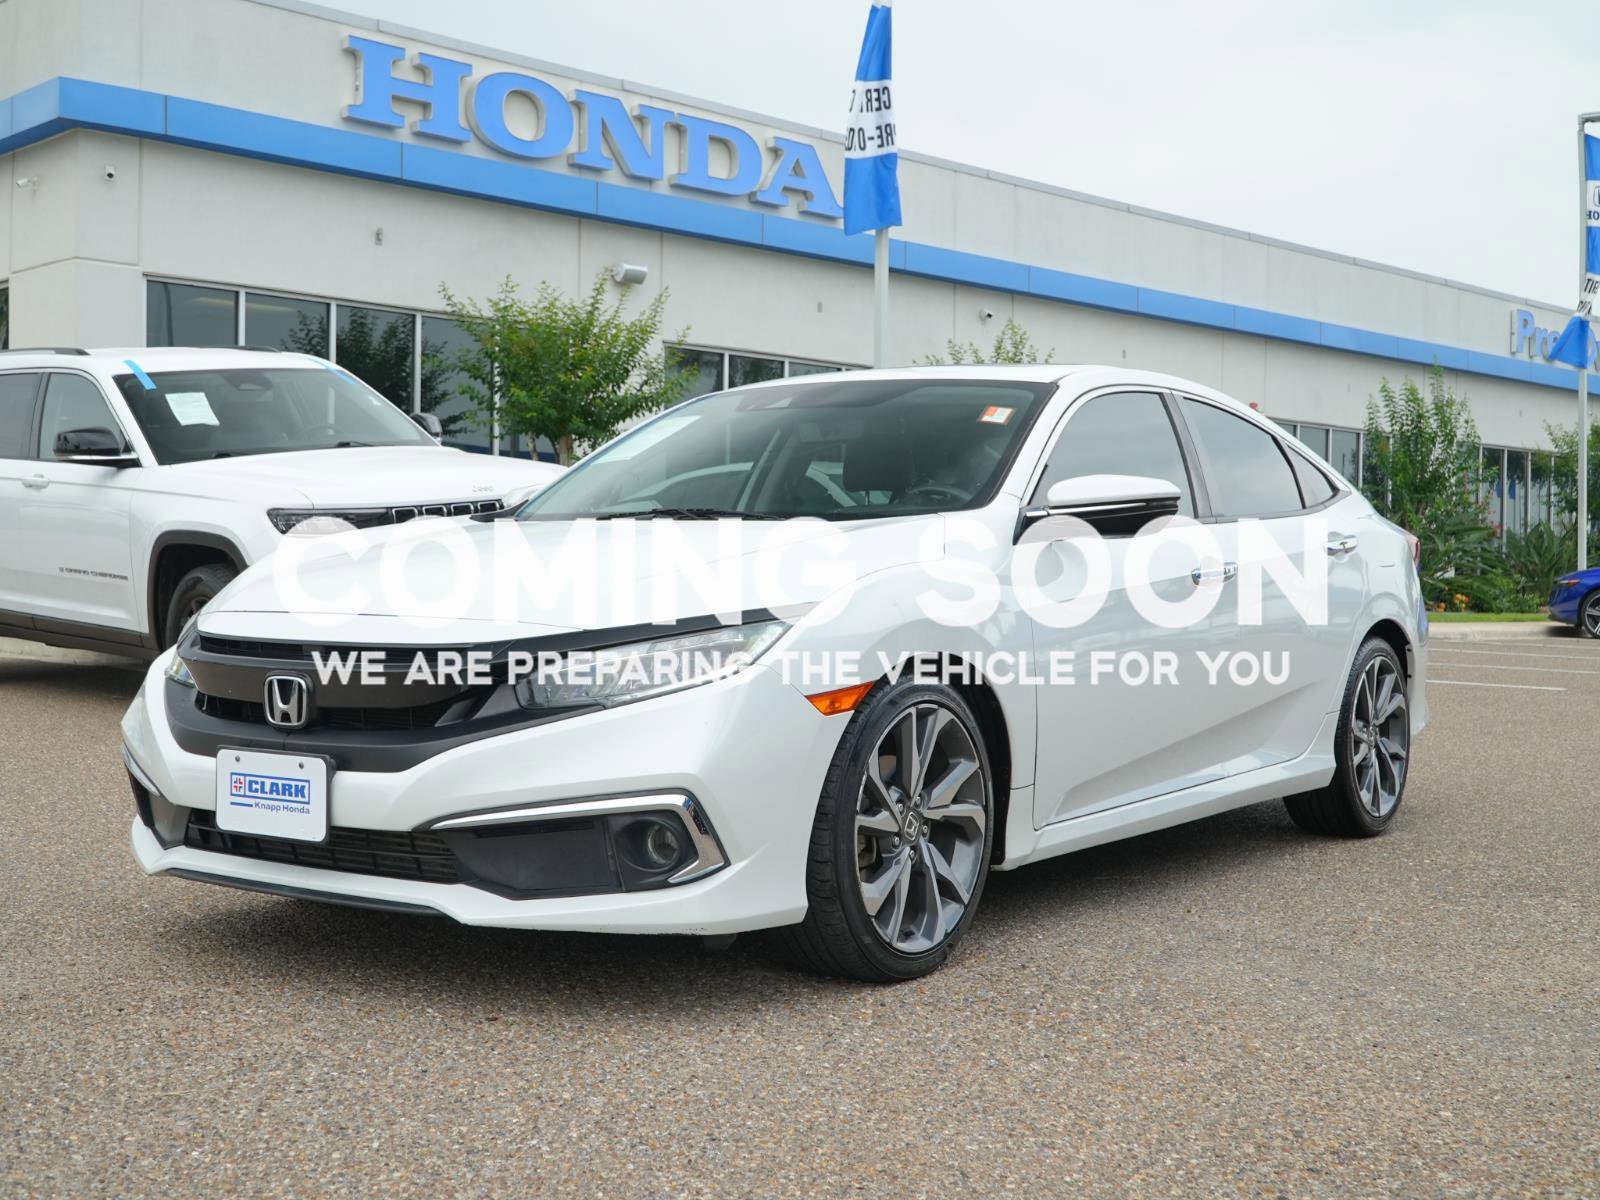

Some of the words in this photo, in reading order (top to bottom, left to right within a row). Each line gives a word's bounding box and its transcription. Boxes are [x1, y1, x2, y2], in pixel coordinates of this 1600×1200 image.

[342, 35, 844, 219] HONDA
[248, 779, 306, 799] CLARK
[255, 802, 281, 812] Knapp
[283, 804, 310, 814] Honda
